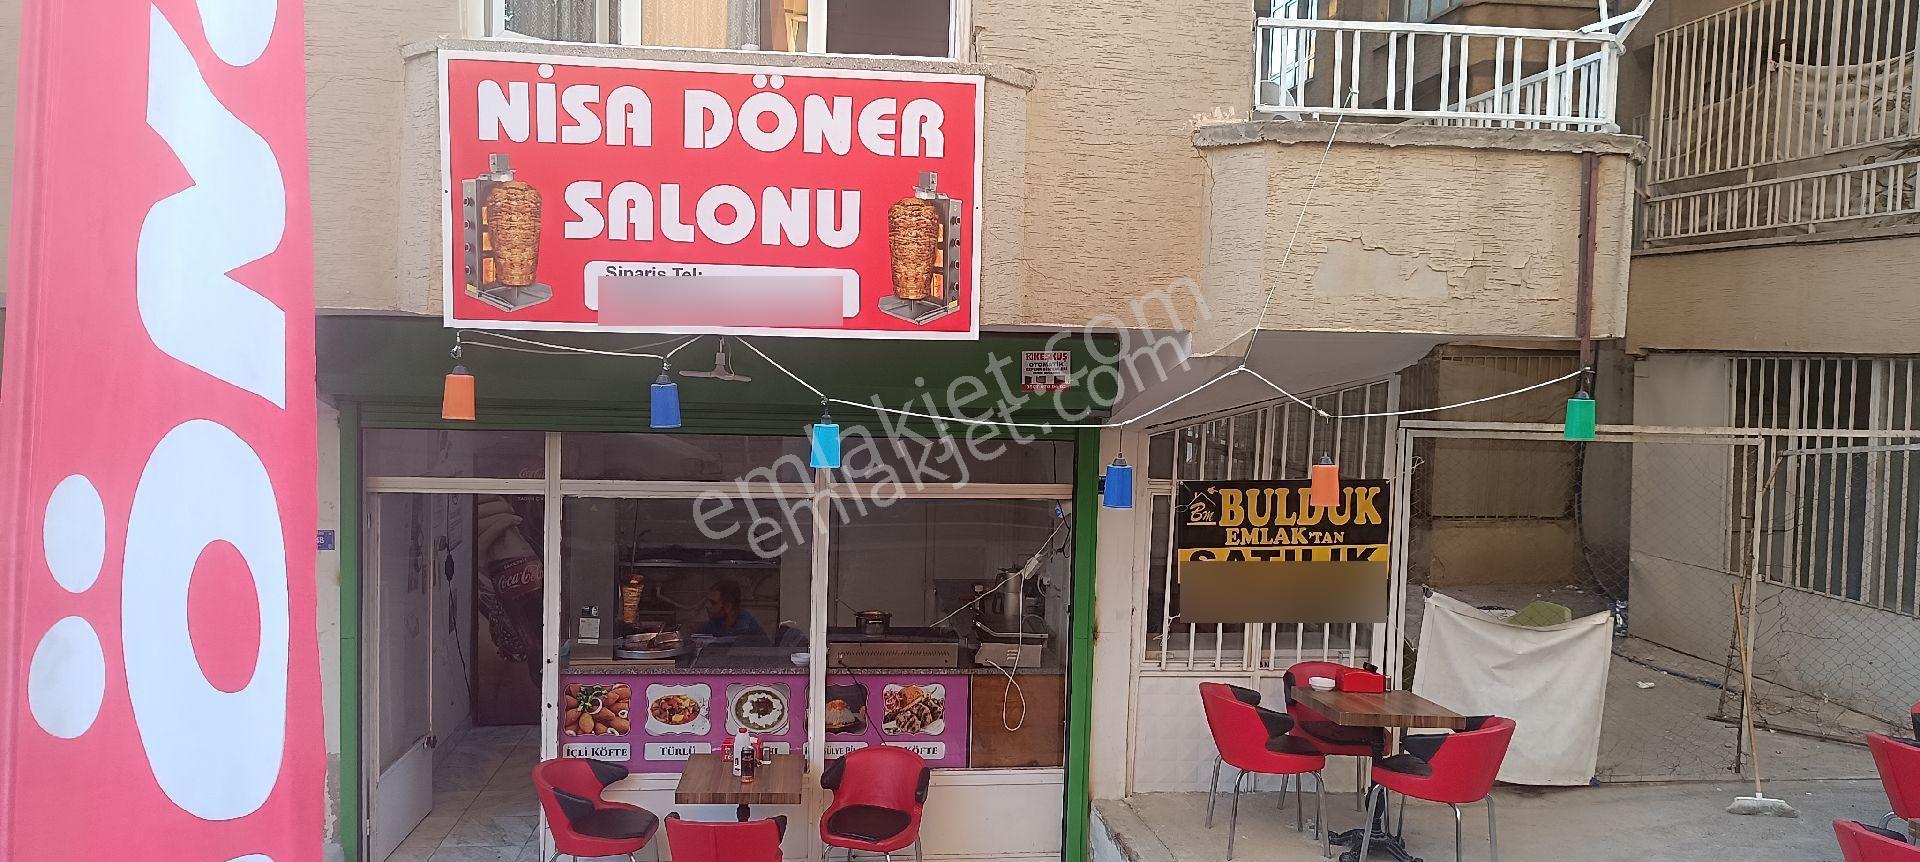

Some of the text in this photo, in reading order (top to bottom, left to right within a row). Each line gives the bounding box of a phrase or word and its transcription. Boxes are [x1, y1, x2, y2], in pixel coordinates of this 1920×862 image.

[477, 63, 945, 159] NİSA DÖNER
[564, 179, 862, 249] SALONU
[28, 0, 289, 862] ÖN
[1218, 486, 1382, 527] BULDUK
[566, 746, 628, 758] İÇLİ KÖFTE
[659, 746, 696, 756] TÜRLÜ
